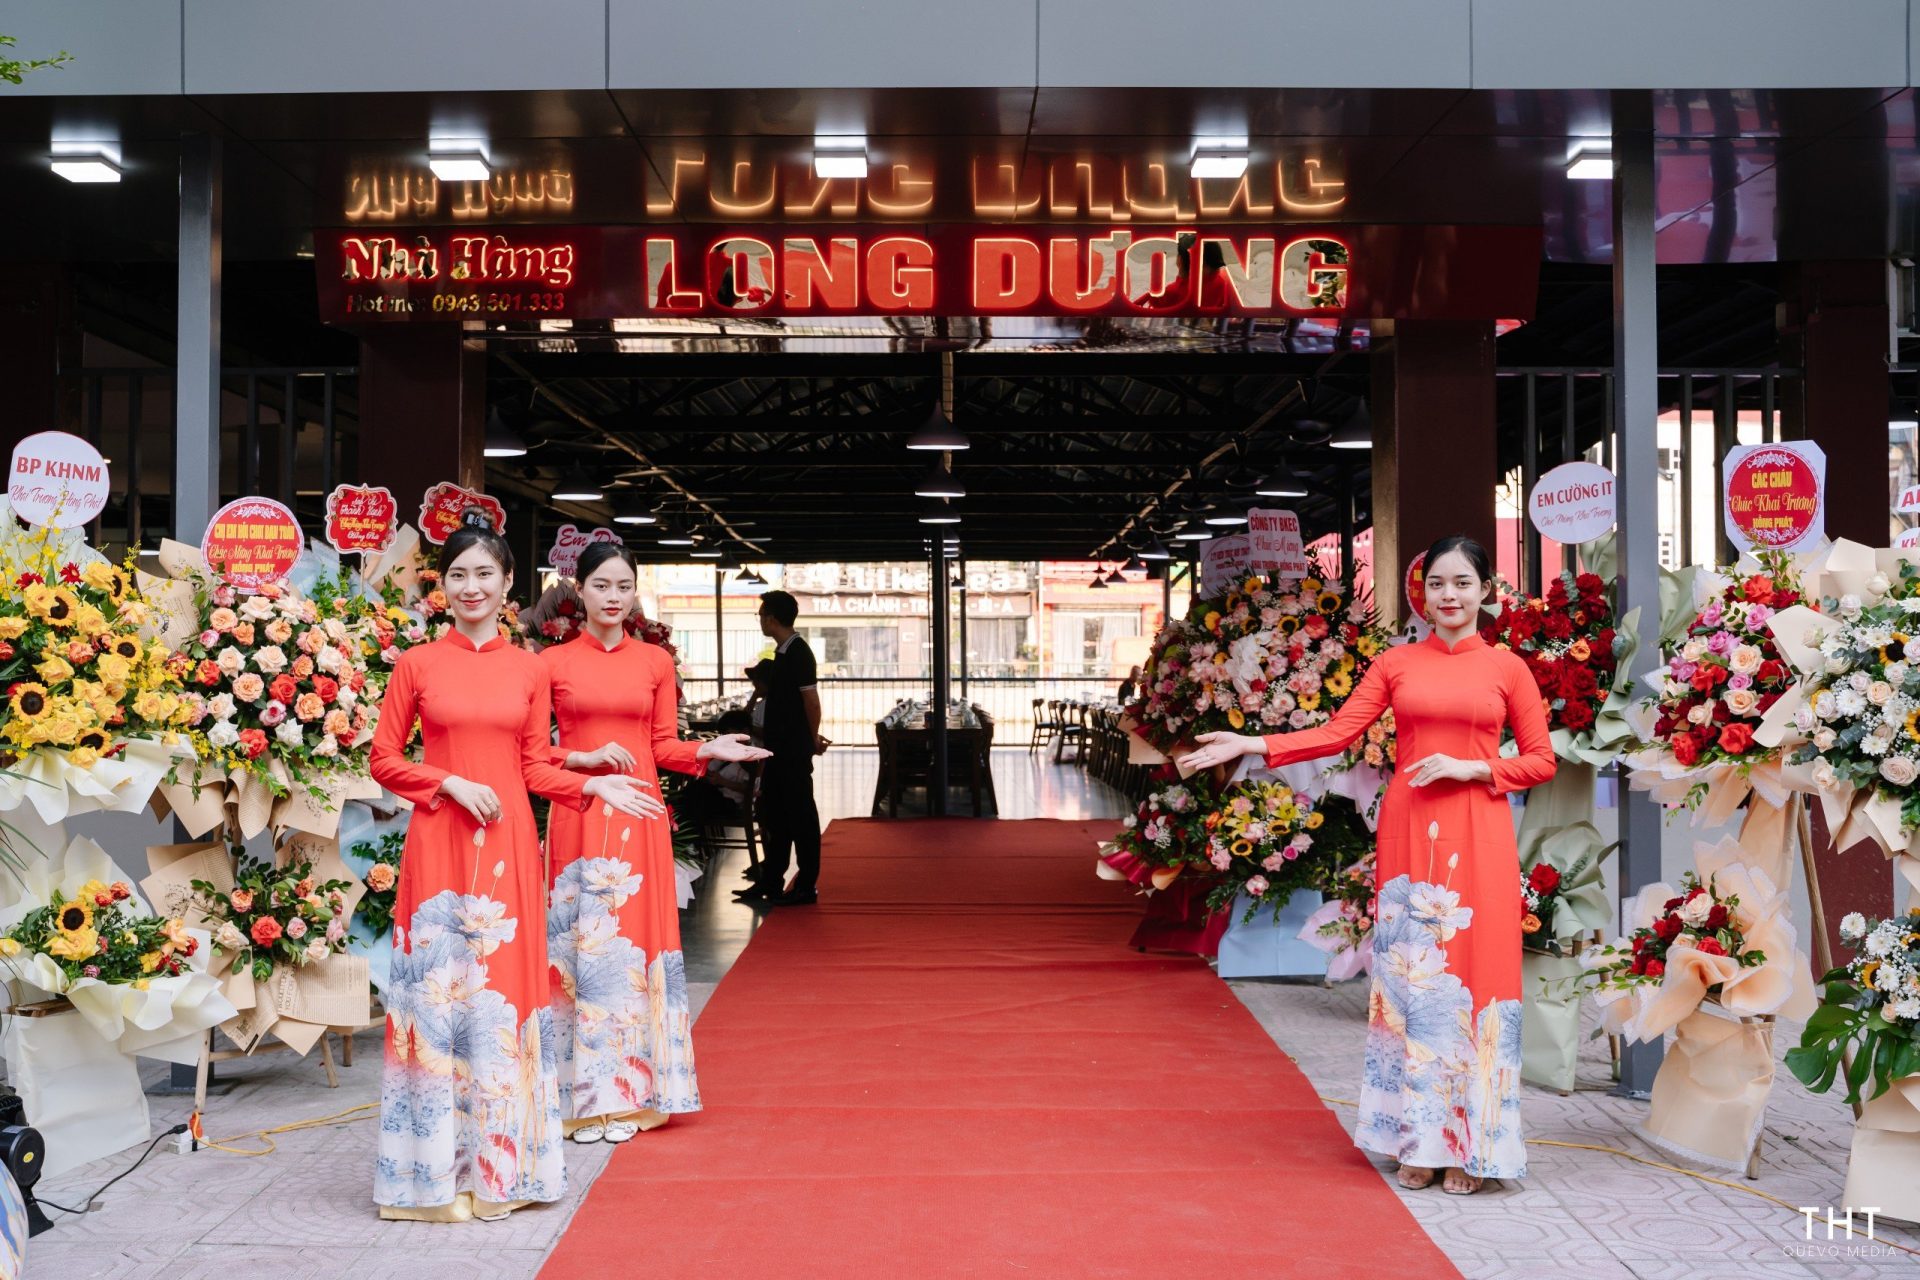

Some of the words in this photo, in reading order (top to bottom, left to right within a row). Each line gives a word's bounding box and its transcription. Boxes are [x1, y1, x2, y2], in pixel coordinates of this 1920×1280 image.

[343, 235, 439, 280] Nhà
[451, 235, 574, 285] Hàng
[645, 237, 934, 310] LONG
[973, 230, 1349, 310] DƯƠNG
[16, 456, 42, 475] BP
[45, 460, 102, 483] KHNM
[1537, 492, 1555, 508] EM
[1557, 482, 1599, 504] CƯỜNG
[1602, 480, 1613, 496] IT
[1754, 493, 1781, 512] Khai
[559, 527, 588, 547] Em
[1269, 517, 1278, 532] TY
